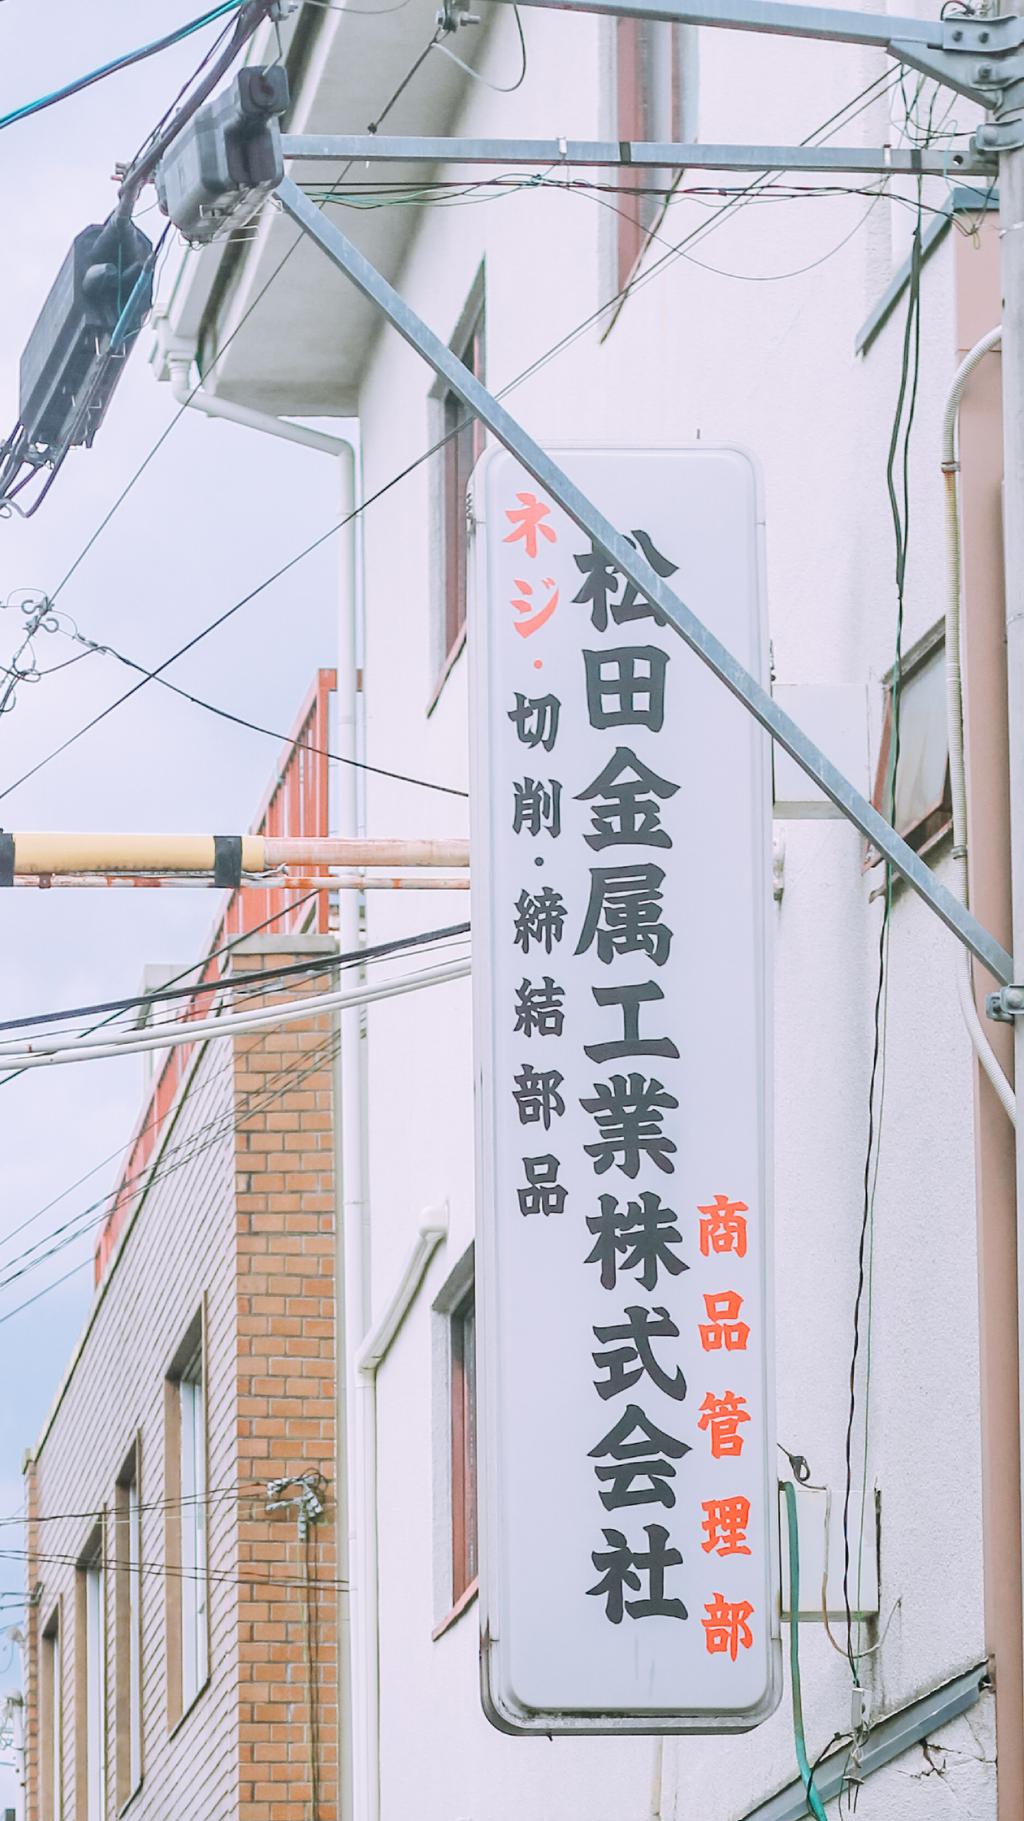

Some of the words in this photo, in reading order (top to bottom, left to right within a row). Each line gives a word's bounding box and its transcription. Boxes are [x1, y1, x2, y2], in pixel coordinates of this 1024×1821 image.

[572, 529, 691, 1625] 松田金属工業株式会社
[697, 1194, 755, 1663] 商品管理部
